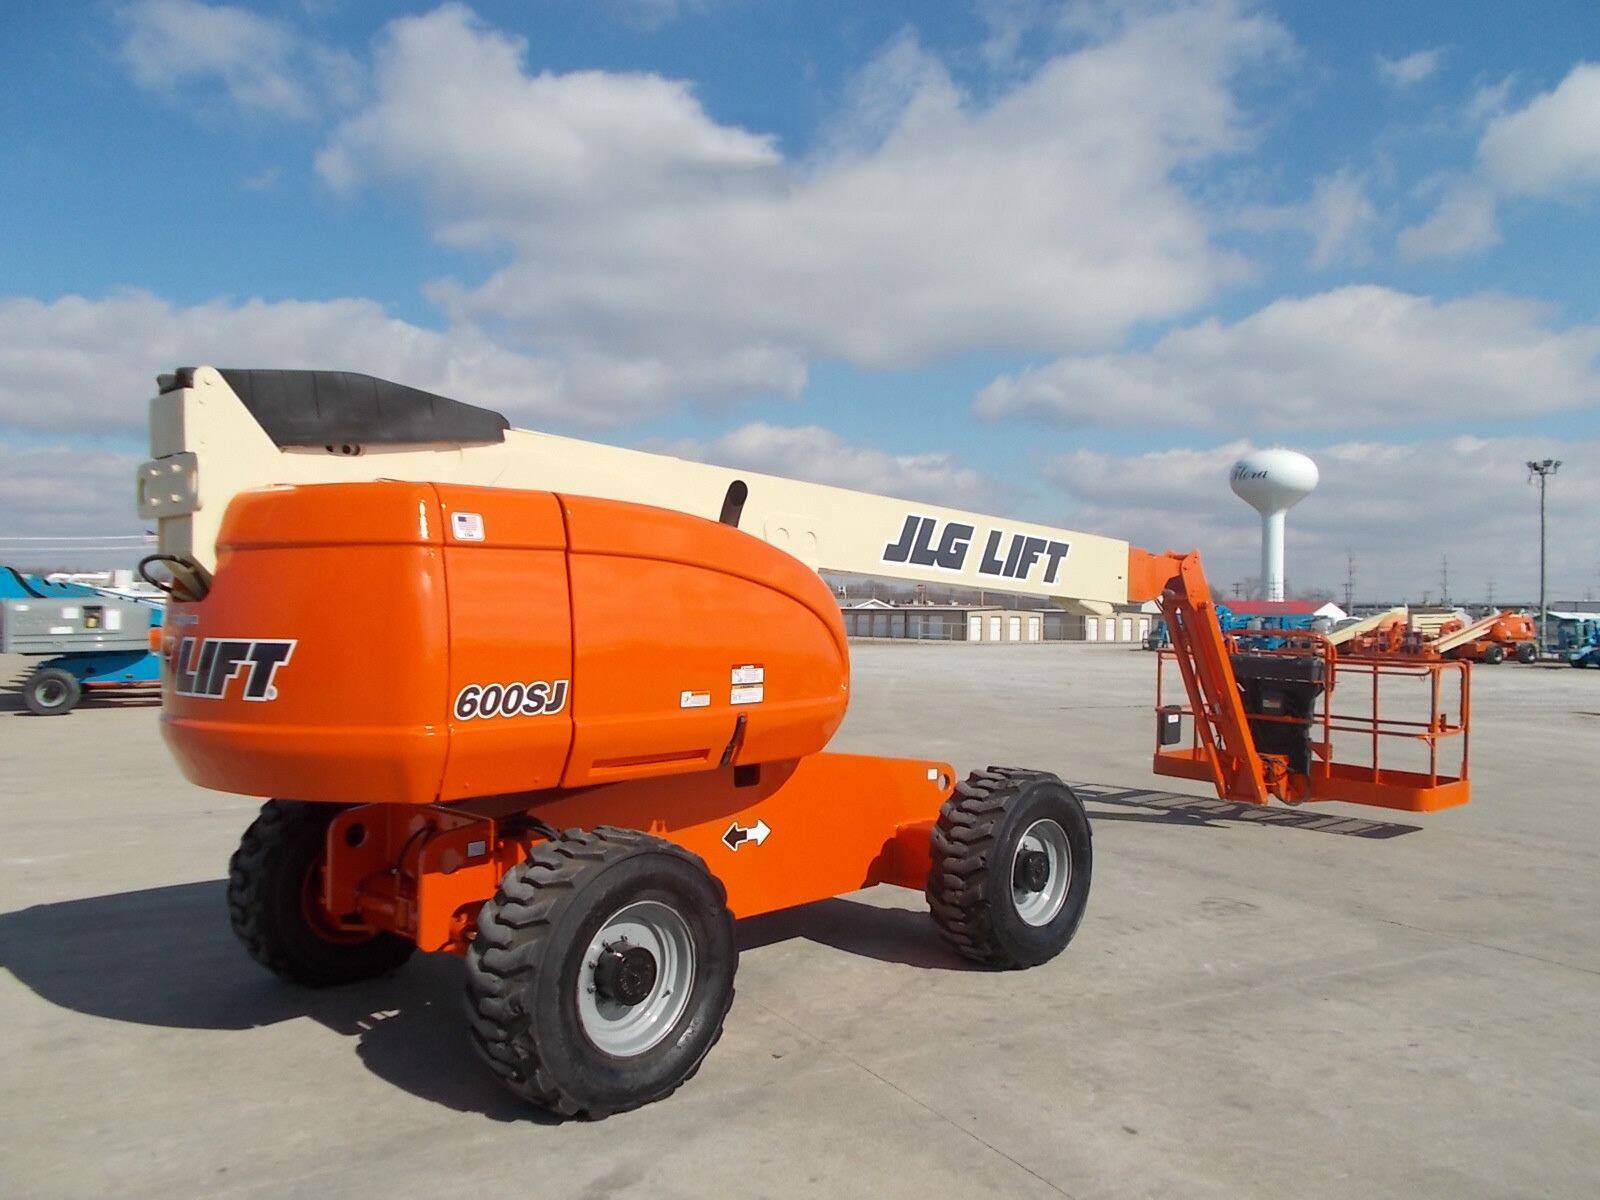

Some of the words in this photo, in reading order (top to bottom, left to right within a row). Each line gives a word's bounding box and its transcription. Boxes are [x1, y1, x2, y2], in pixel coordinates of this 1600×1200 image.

[882, 514, 976, 571] JLG
[978, 529, 1070, 584] LIFT
[176, 637, 297, 701] LIFT
[455, 680, 568, 720] 600SJ
